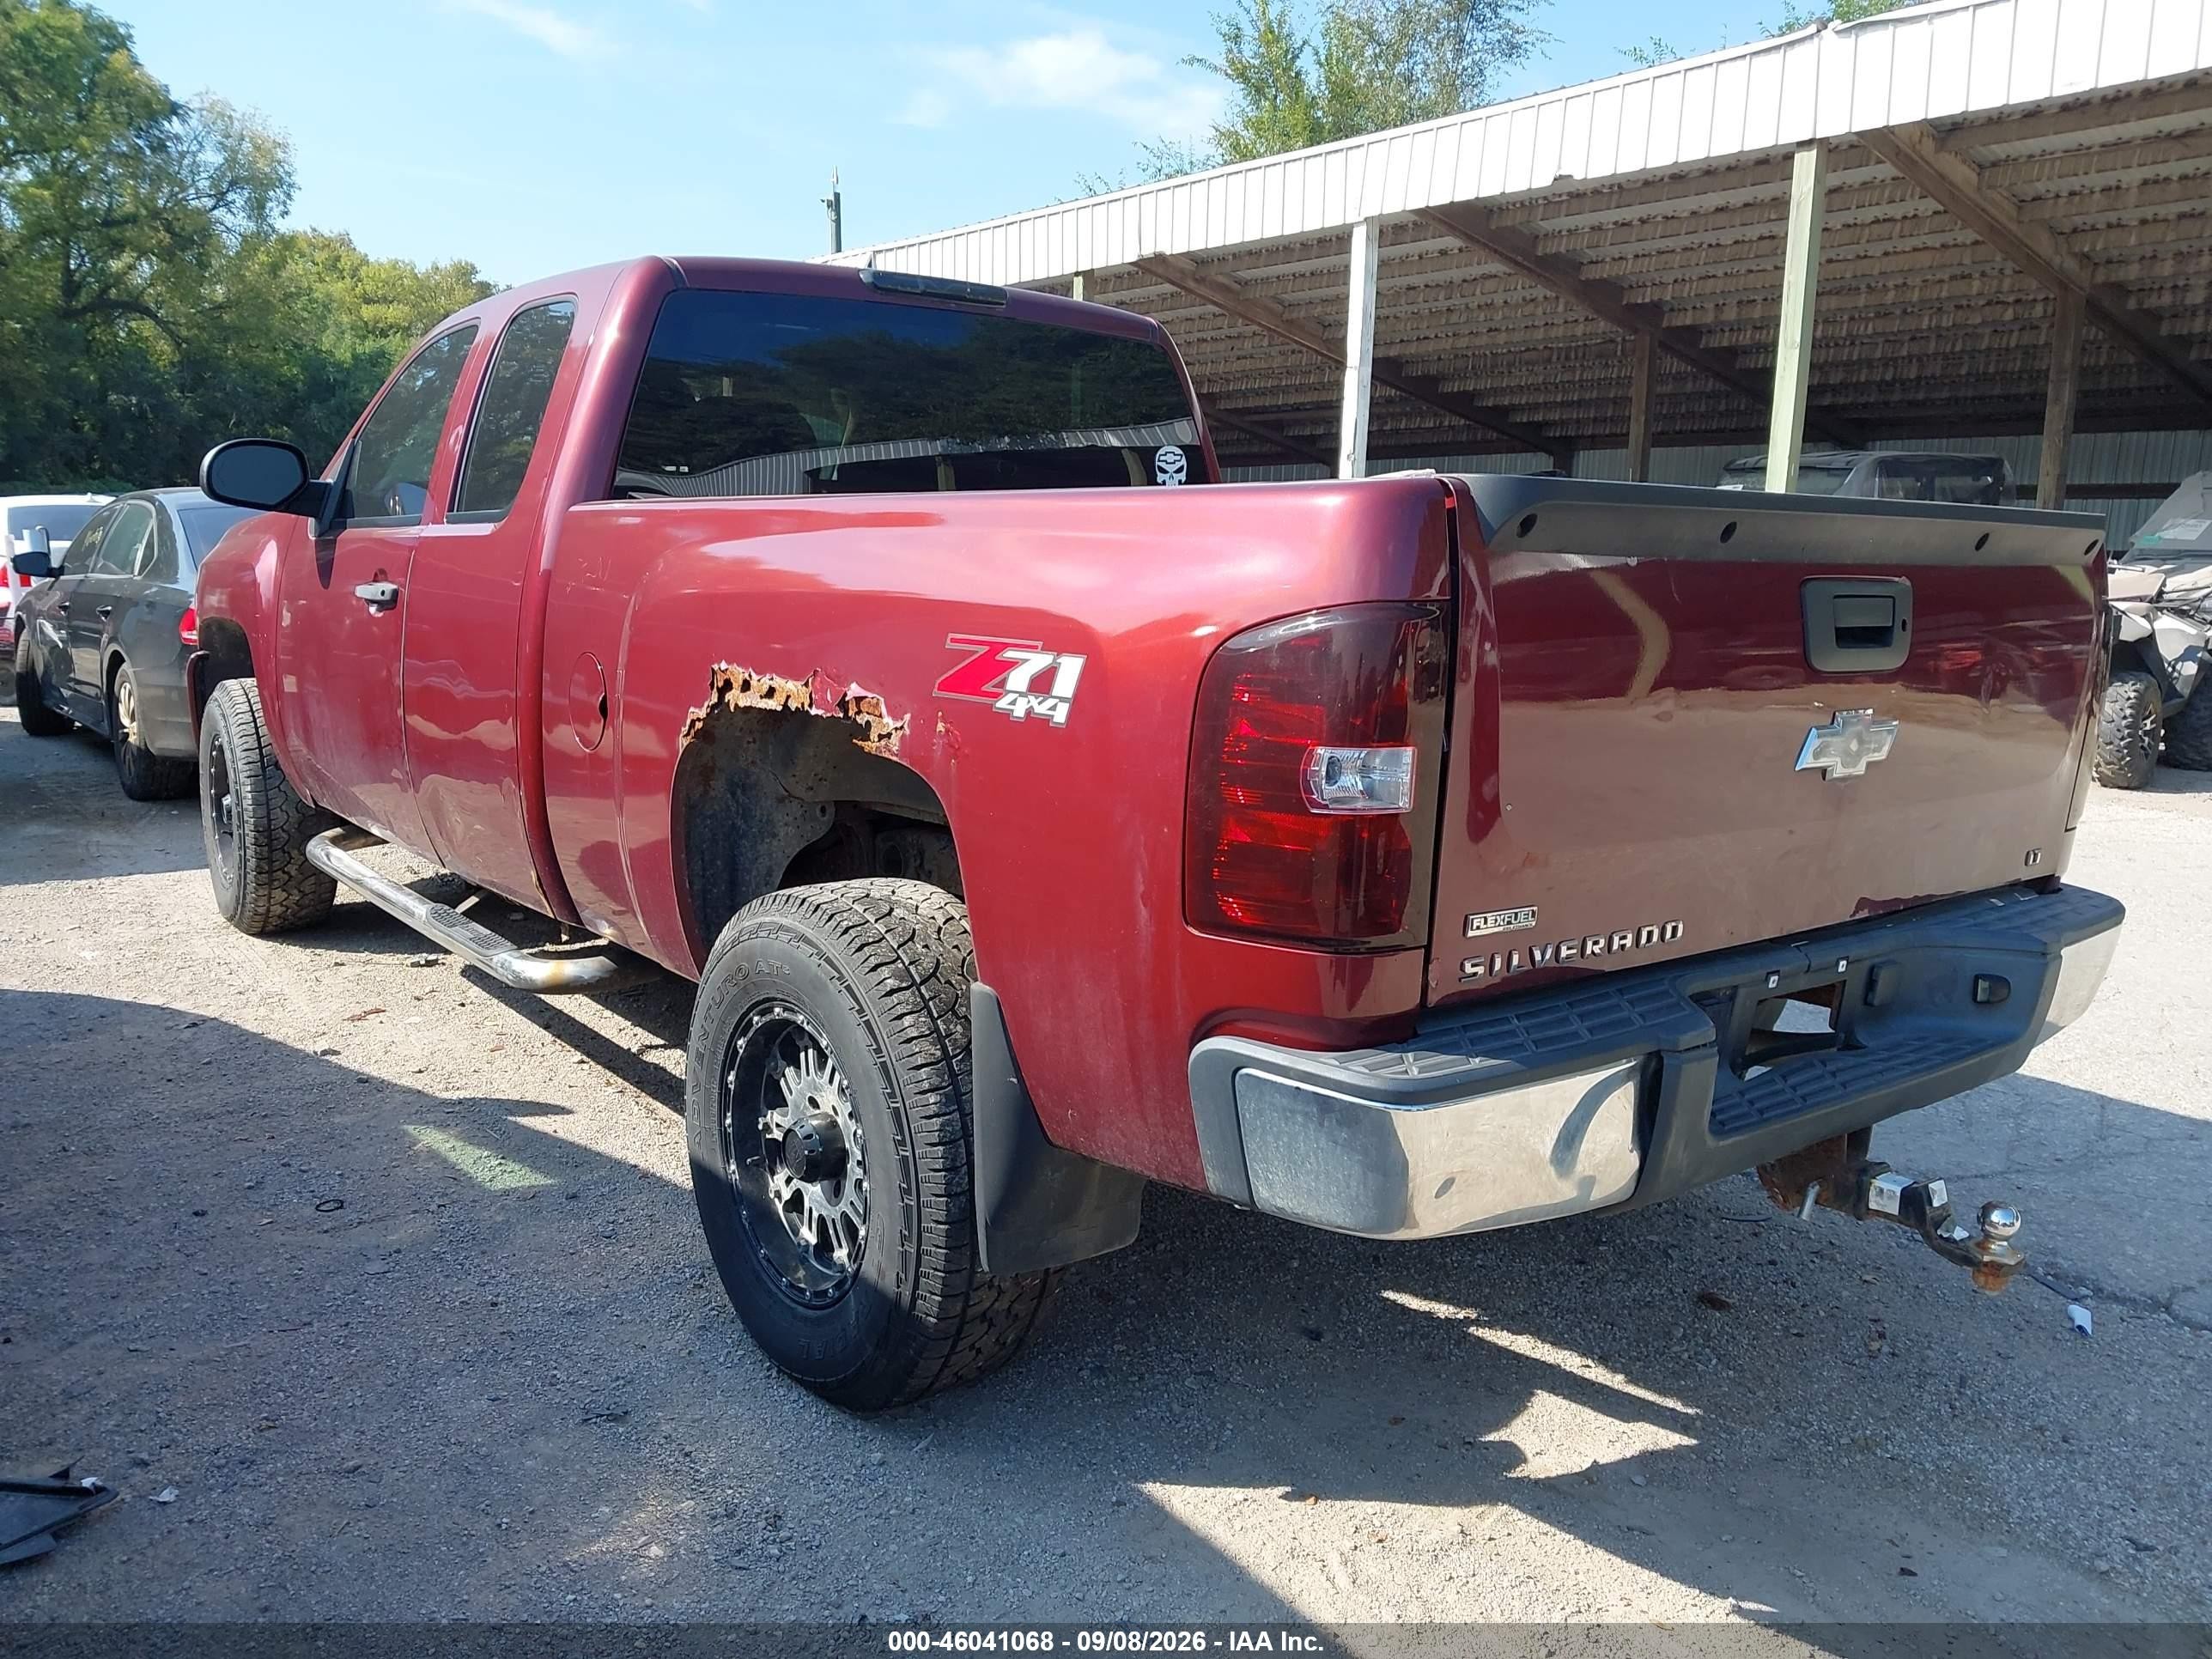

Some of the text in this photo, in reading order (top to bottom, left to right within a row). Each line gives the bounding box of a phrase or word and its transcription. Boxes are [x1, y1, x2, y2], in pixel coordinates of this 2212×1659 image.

[933, 633, 1087, 704] Z71
[1460, 919, 1685, 983] SILVERADO
[1472, 910, 1535, 930] FLEXFUEL
